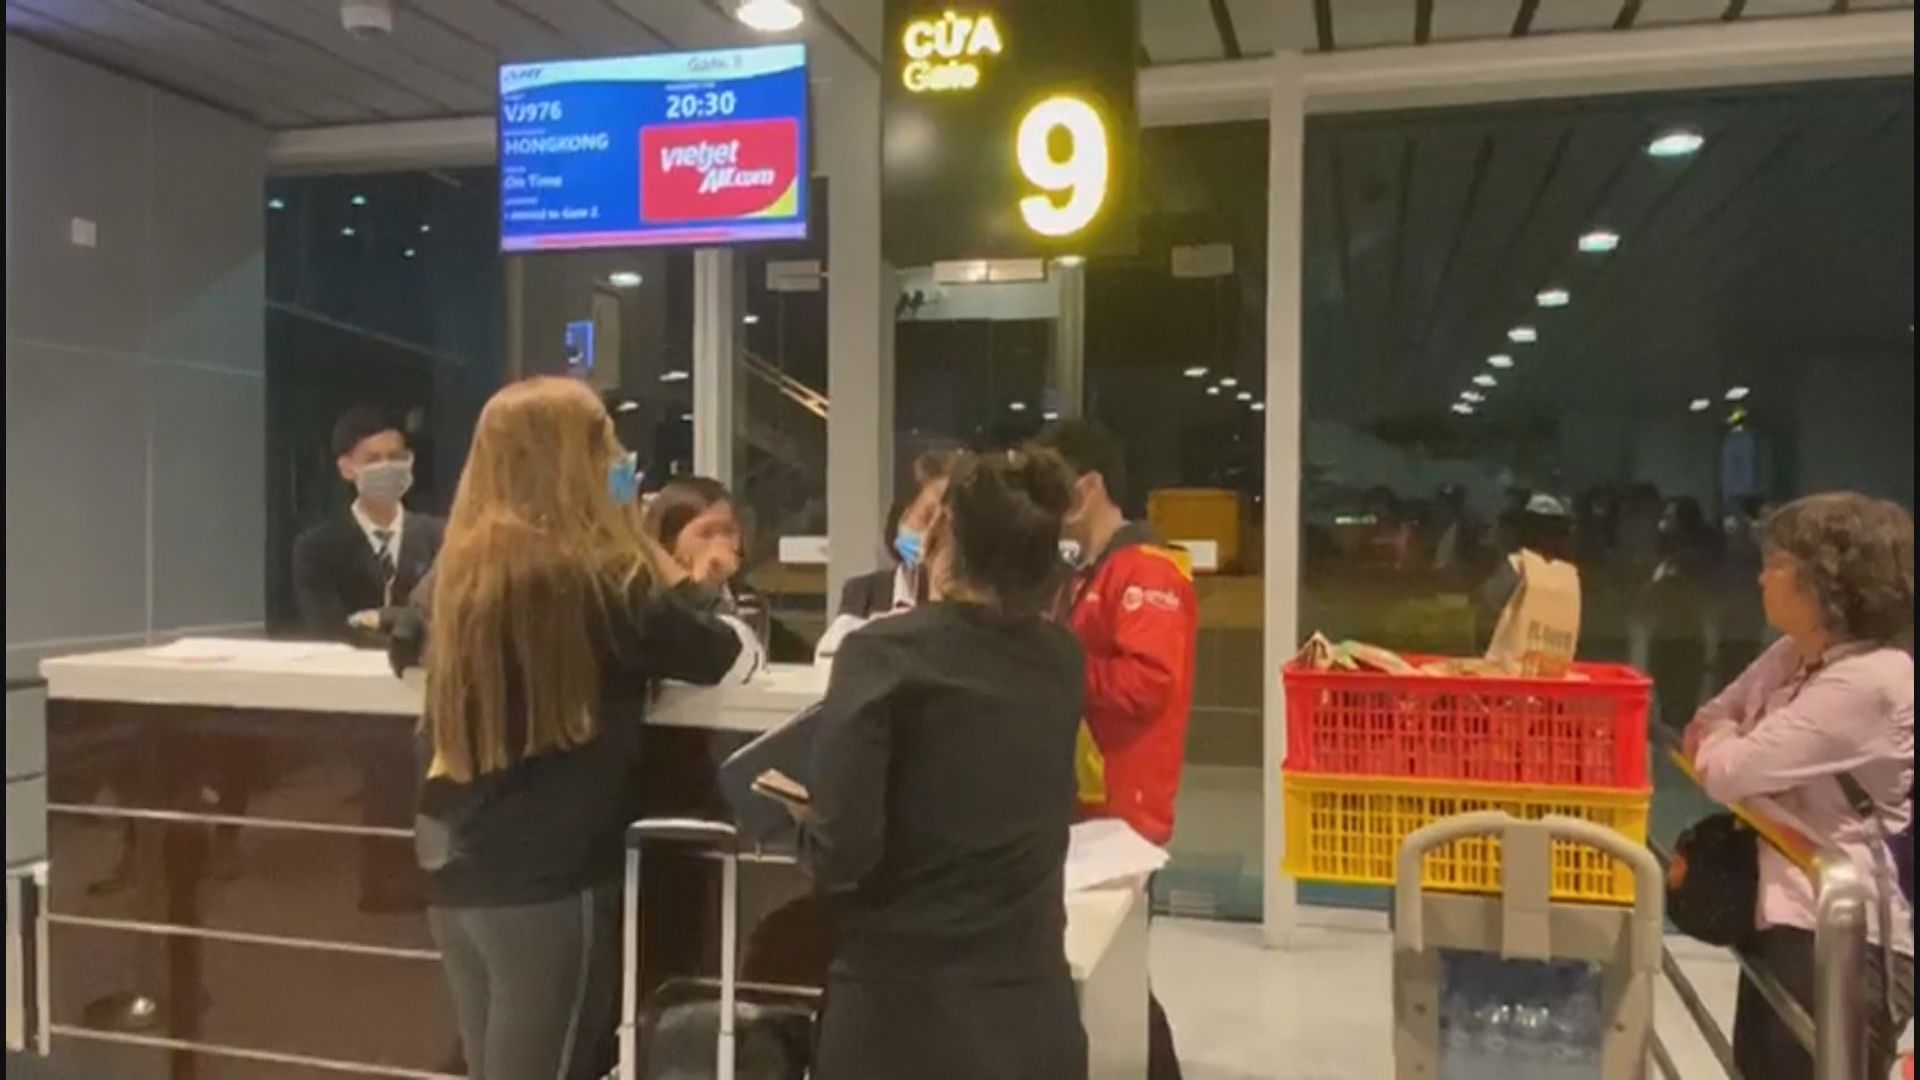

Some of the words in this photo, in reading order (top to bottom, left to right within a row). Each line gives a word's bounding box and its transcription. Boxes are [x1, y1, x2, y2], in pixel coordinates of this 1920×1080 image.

[903, 10, 1003, 58] CỬA
[903, 60, 980, 91] Gate
[504, 101, 562, 122] VJ976
[666, 91, 736, 118] 20:30
[504, 132, 609, 154] HONGKONG
[1017, 97, 1108, 236] 9
